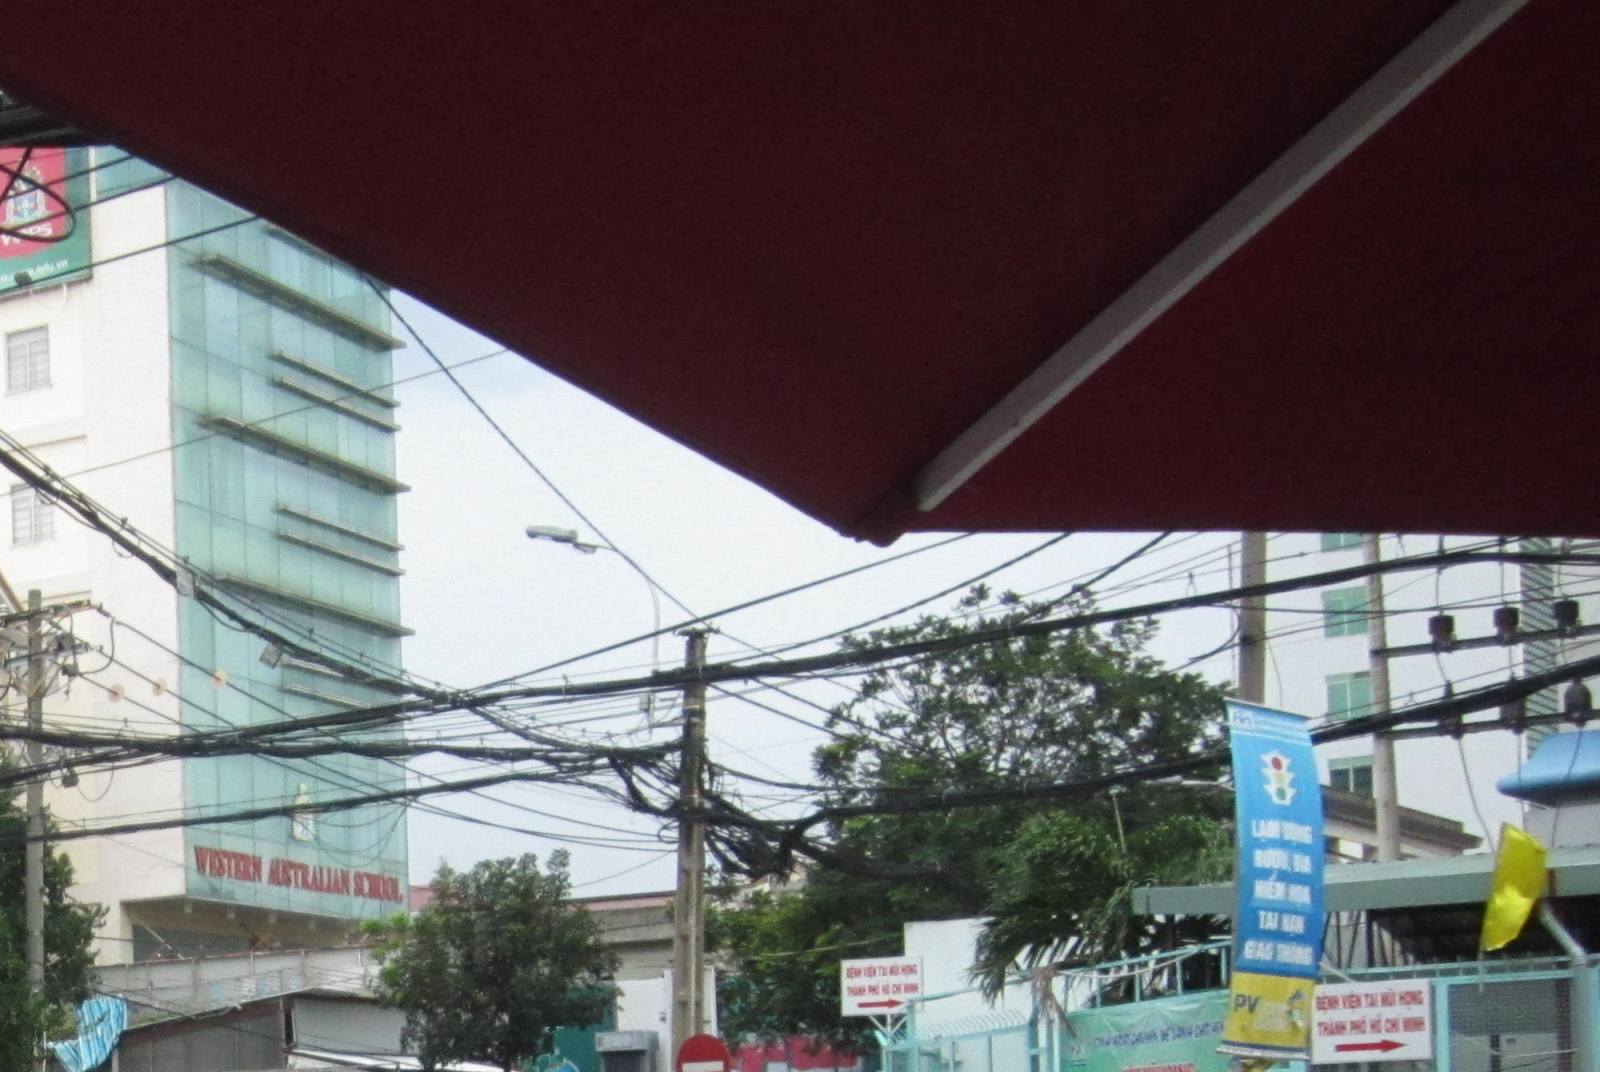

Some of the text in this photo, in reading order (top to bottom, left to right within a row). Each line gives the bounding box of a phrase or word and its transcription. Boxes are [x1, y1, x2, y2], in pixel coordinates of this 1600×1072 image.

[195, 846, 403, 903] WESTERN AUSTRALIAN SCHOOL
